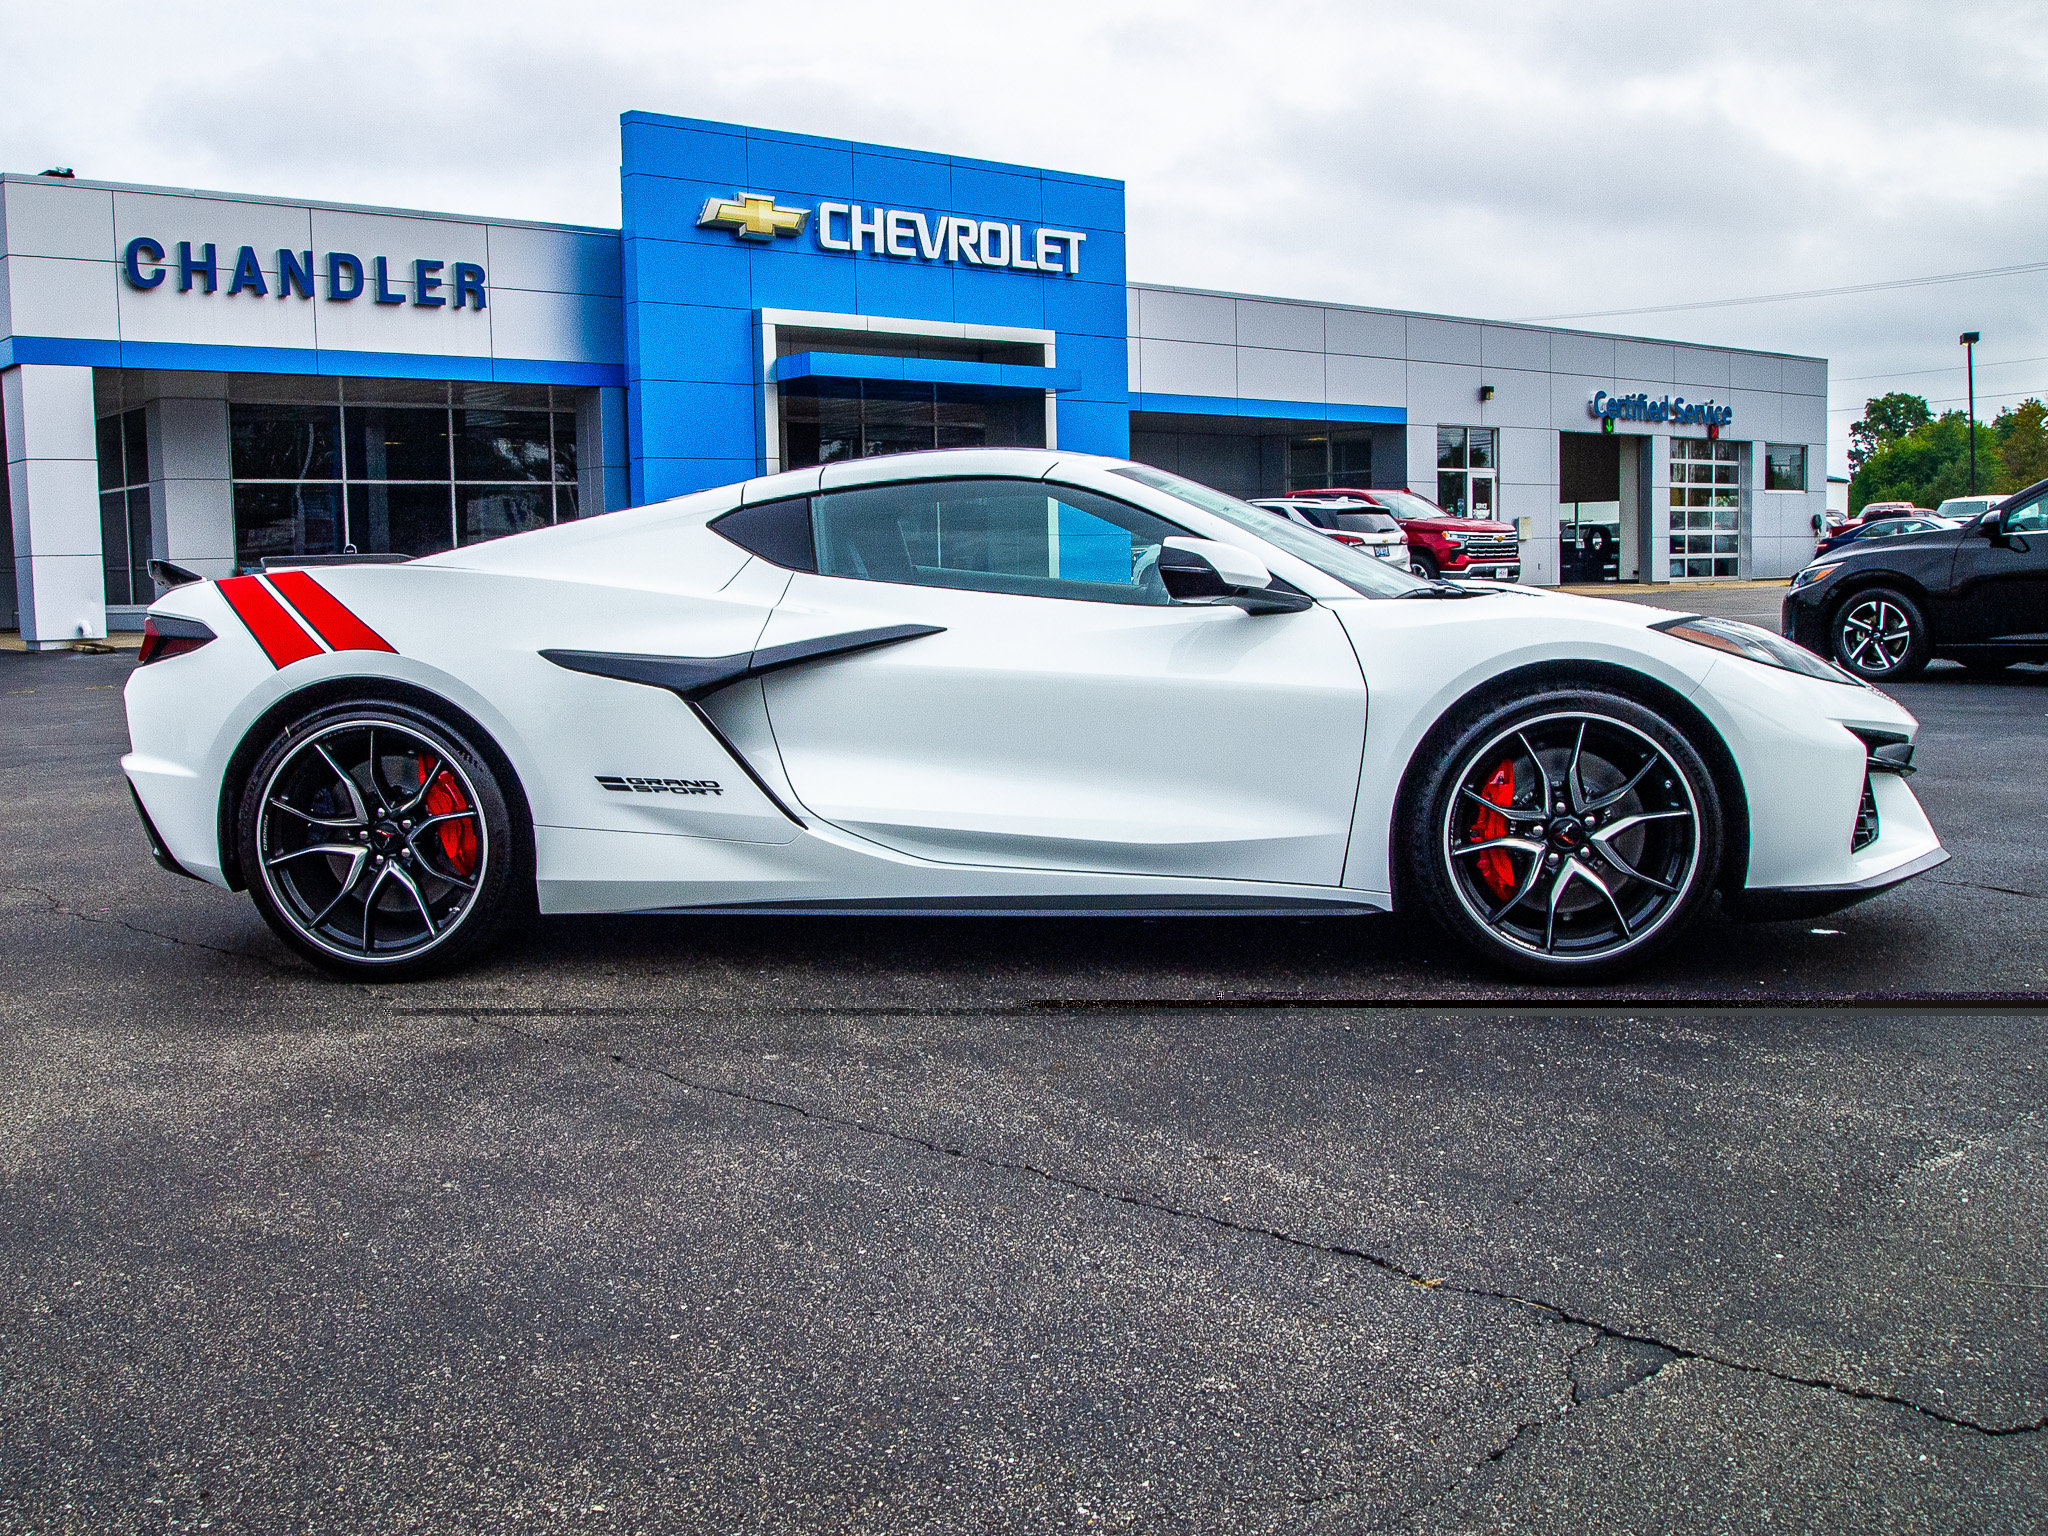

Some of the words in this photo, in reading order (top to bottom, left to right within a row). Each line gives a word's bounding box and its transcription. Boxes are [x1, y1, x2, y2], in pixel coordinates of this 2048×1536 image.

[818, 202, 1087, 275] CHEVROLET
[125, 237, 488, 310] CHANDLER
[1594, 390, 1669, 421] Certified
[1674, 397, 1733, 425] Service
[625, 777, 720, 787] GRAND
[632, 785, 723, 795] SPORT
